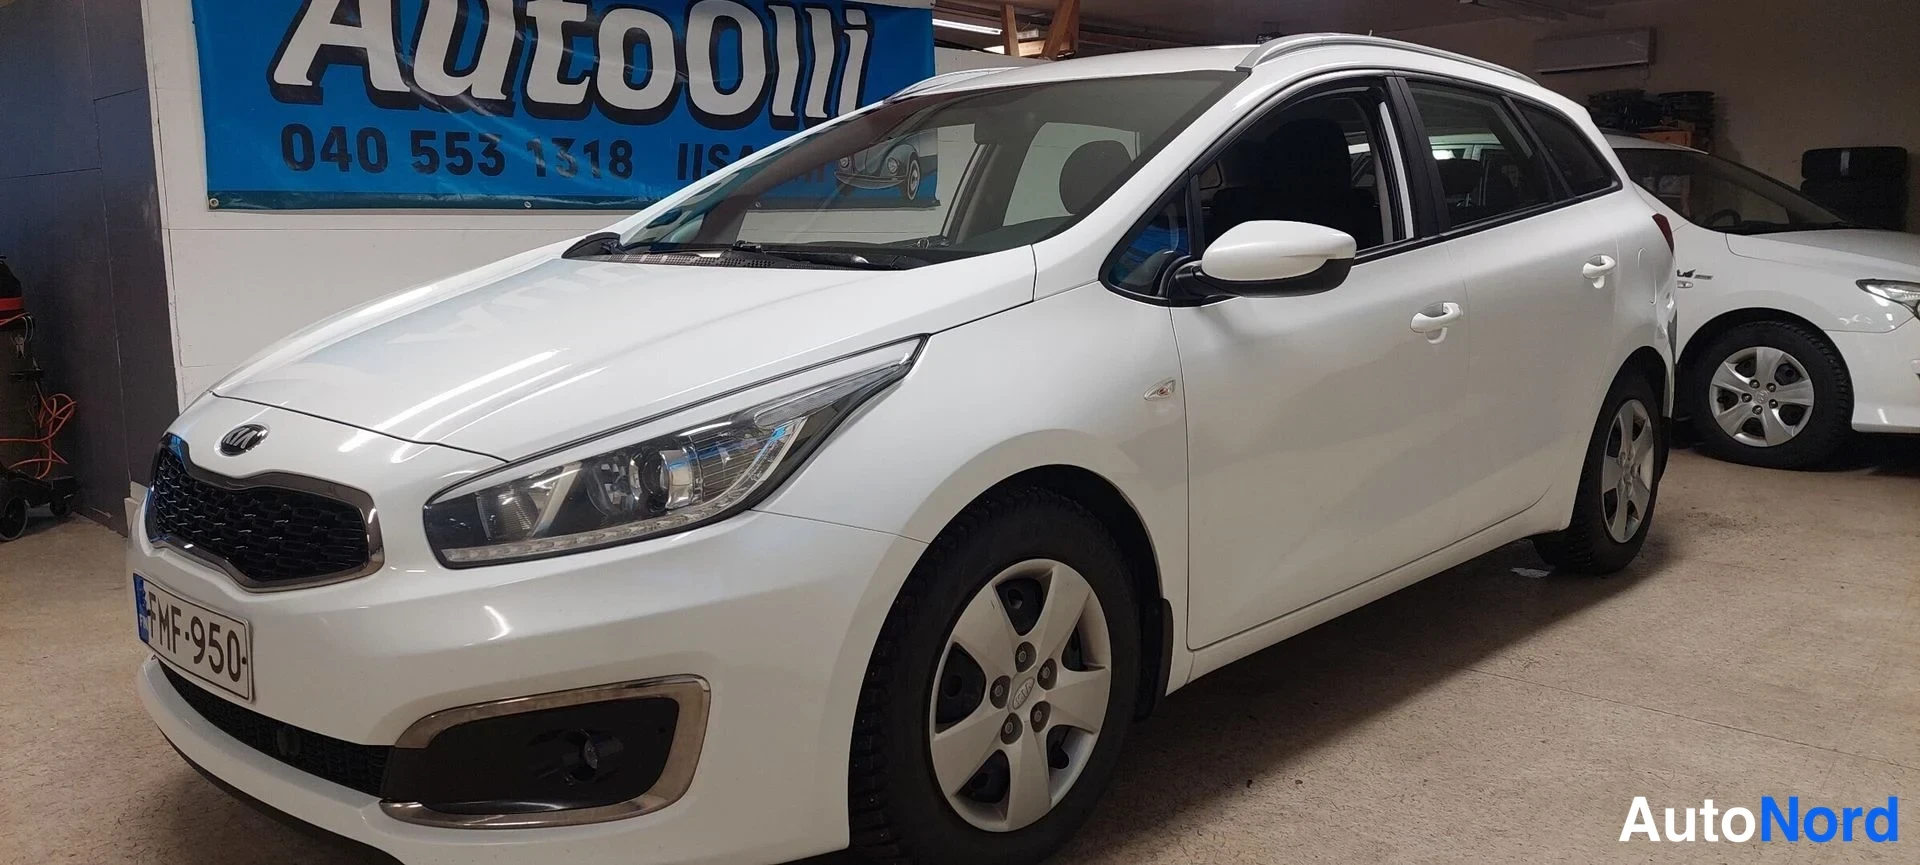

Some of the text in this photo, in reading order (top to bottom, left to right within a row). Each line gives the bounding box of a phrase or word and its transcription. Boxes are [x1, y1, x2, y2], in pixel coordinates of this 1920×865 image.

[269, 0, 870, 123] AutoOlli
[281, 123, 389, 174] 040
[410, 130, 506, 177] 553
[526, 136, 633, 180] 1318
[222, 427, 258, 449] KIA
